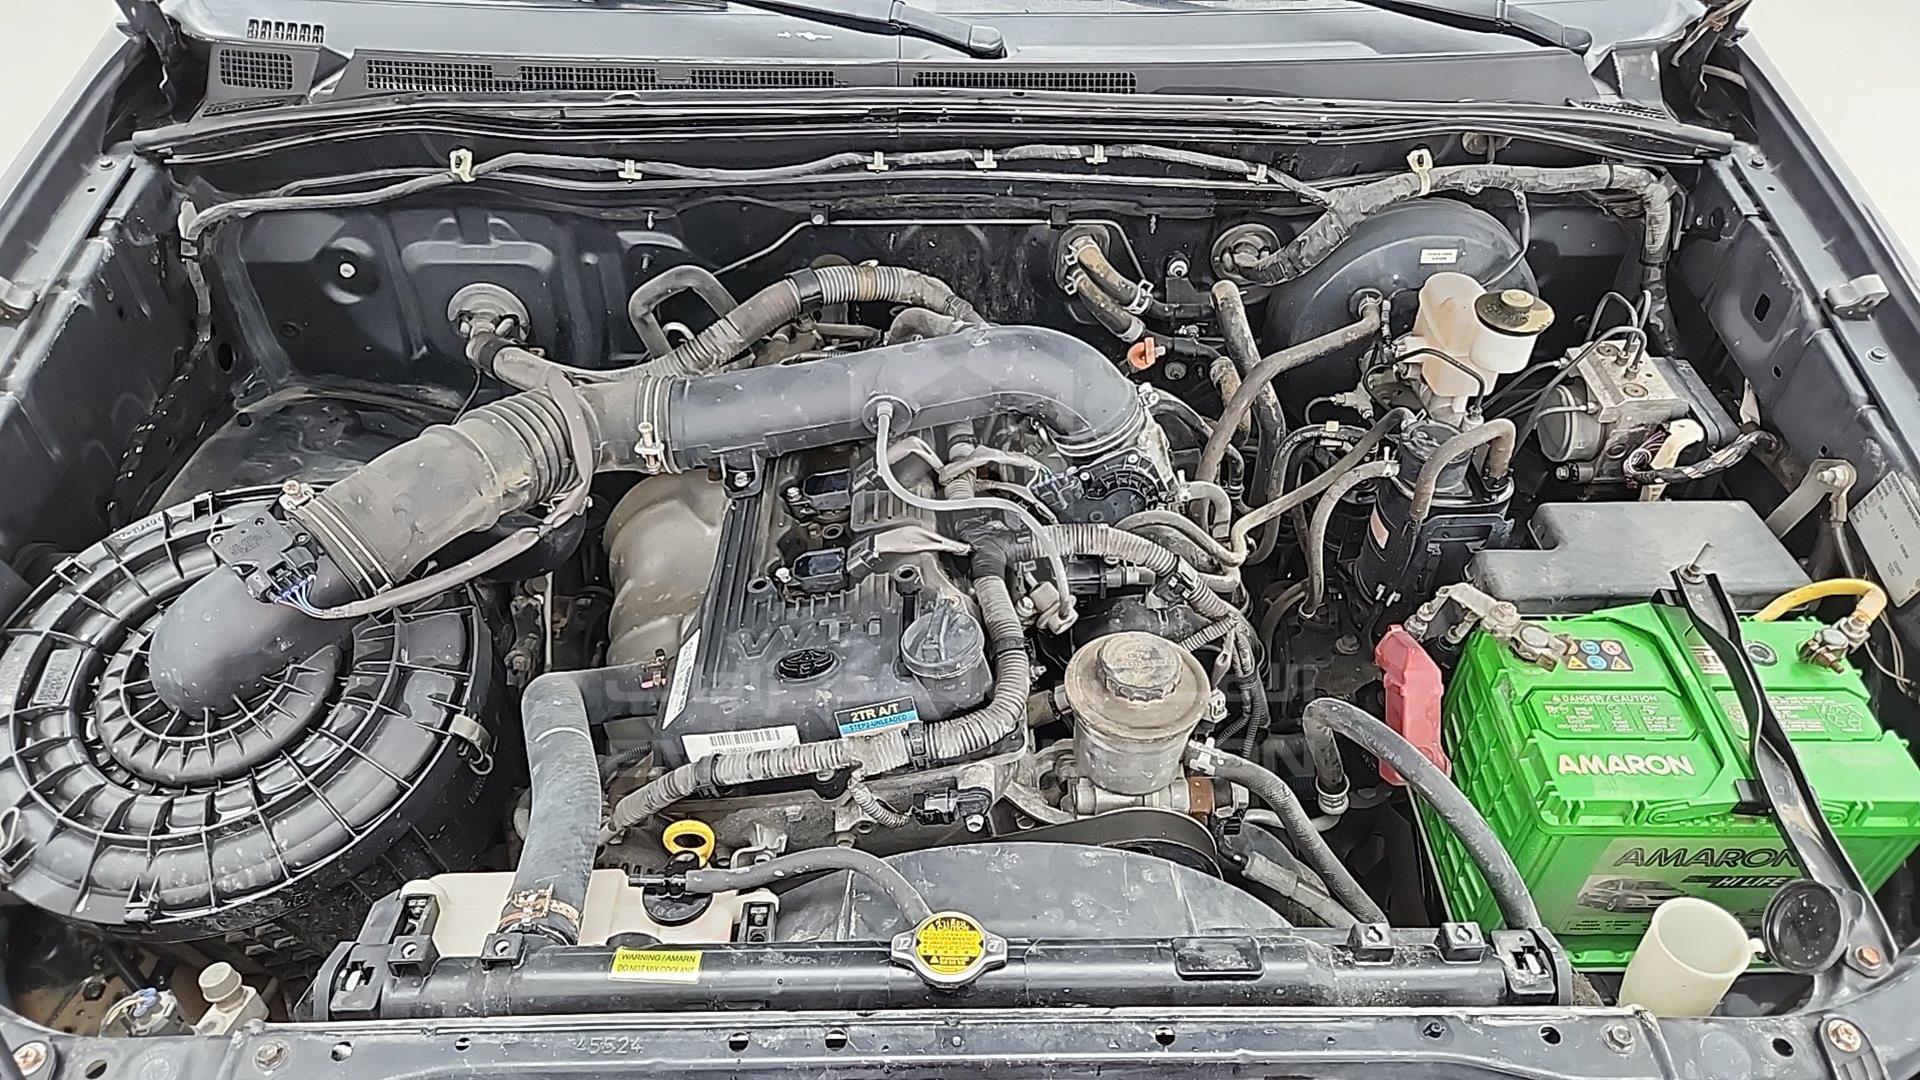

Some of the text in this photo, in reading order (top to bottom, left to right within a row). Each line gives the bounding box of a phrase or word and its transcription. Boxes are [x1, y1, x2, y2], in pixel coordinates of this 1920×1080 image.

[1562, 695, 1602, 703] DANGER
[1612, 695, 1657, 703] CAUTION
[850, 703, 899, 722] 2TR A/T
[849, 714, 908, 731] STEP2-UNLEADED
[1558, 753, 1696, 776] AMARON
[1614, 847, 1798, 868] AMARON
[1715, 877, 1788, 887] HI LIFE
[621, 953, 661, 961] WARNING
[617, 963, 629, 972] DO
[630, 964, 645, 972] NOT
